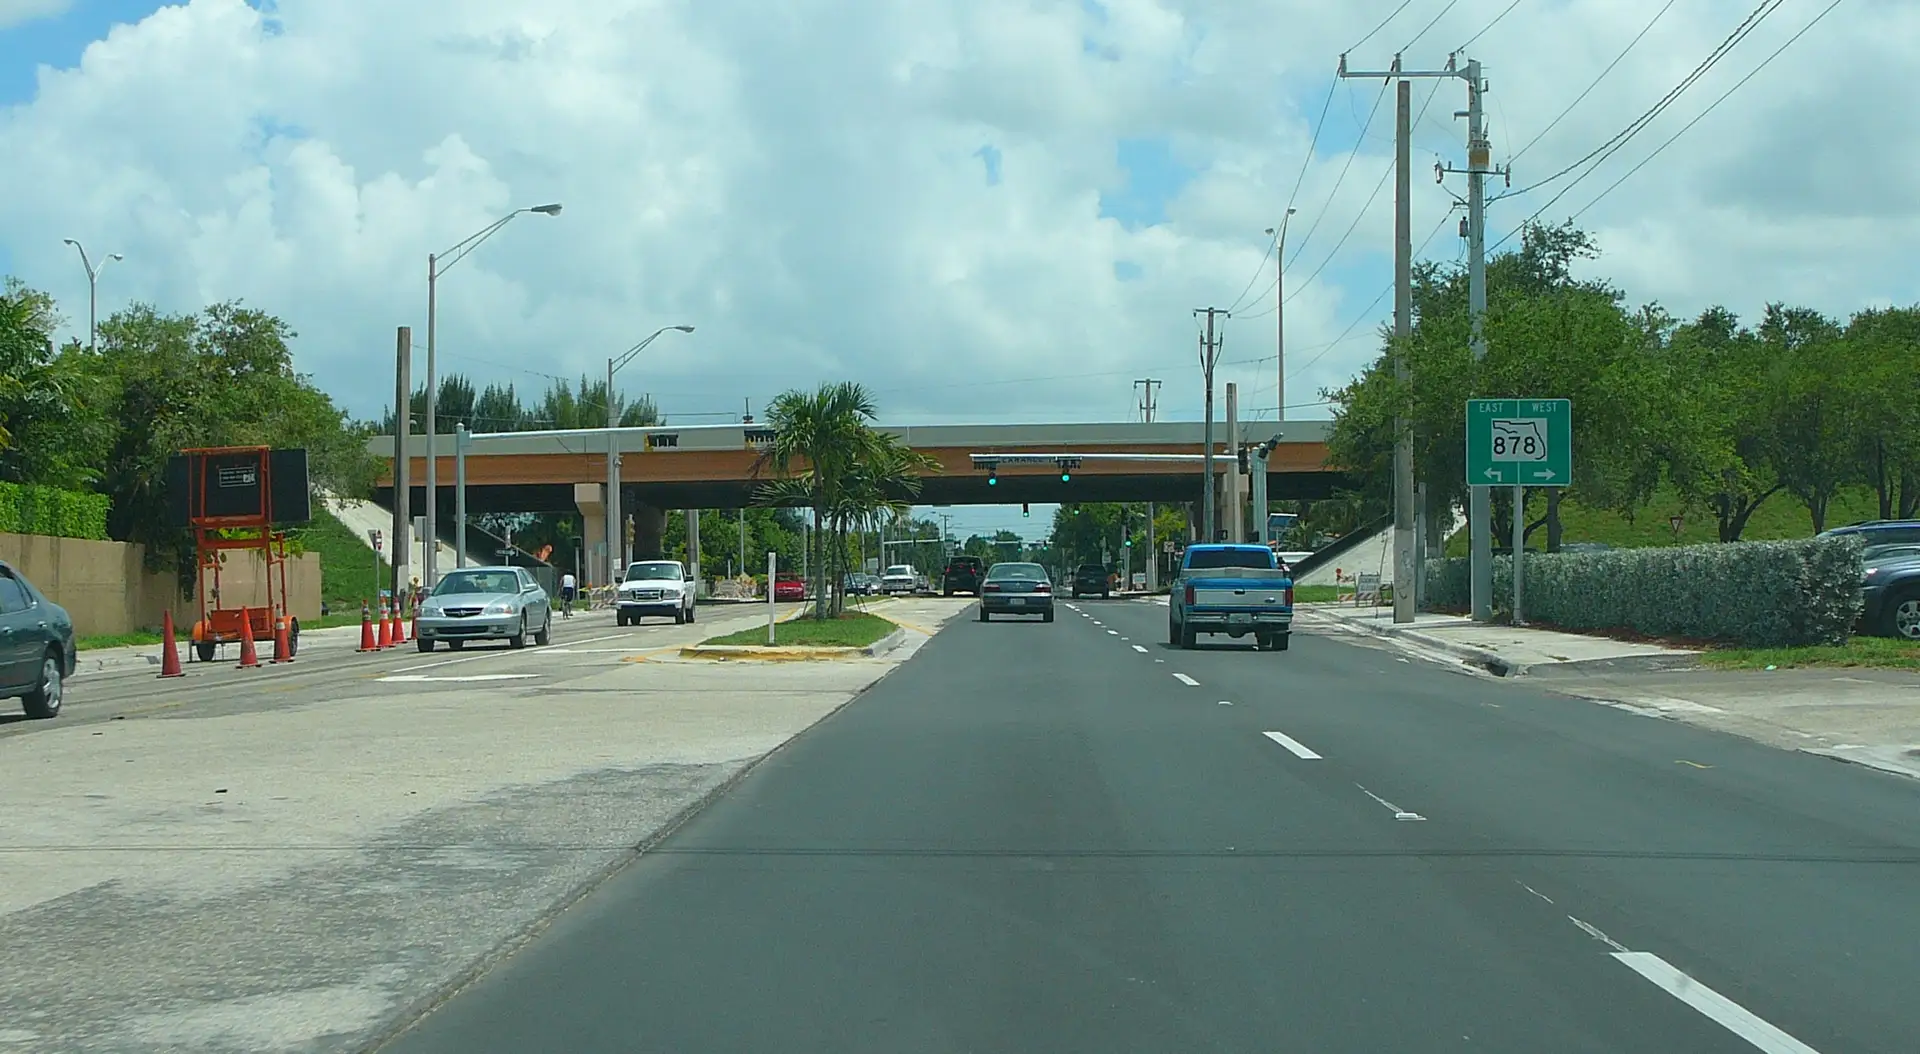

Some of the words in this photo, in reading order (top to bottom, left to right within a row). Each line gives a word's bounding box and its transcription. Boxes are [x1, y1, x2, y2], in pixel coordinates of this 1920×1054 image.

[1479, 403, 1503, 413] EAST
[1532, 402, 1557, 412] WEST
[1494, 436, 1536, 455] 878
